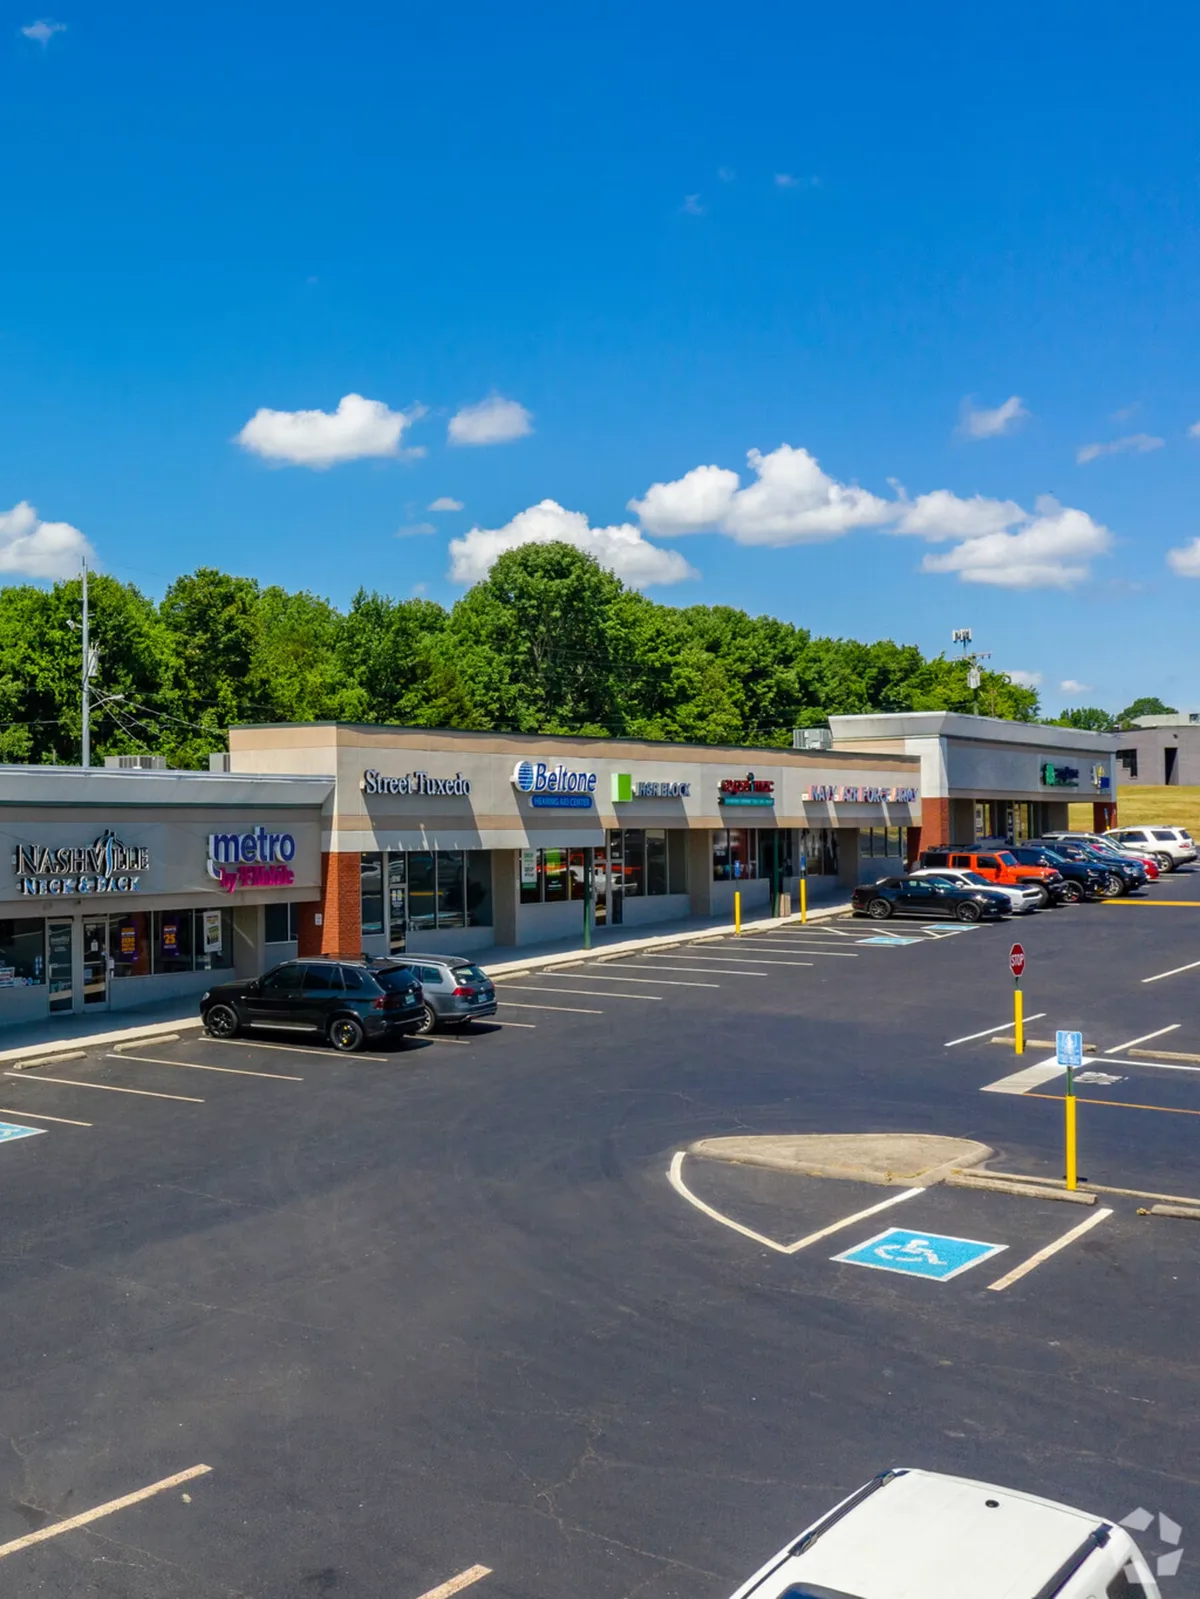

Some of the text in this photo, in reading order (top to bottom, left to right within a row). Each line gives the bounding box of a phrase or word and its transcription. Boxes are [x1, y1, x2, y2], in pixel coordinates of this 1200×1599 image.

[364, 769, 472, 796] Street Tuxedo
[534, 762, 597, 791] Beltone
[660, 782, 691, 797] BLOCK
[808, 785, 837, 802] NAVY
[860, 787, 891, 803] FORCE
[894, 787, 919, 803] ARMY
[208, 826, 295, 864] metro
[16, 839, 150, 877] NASHVILLE
[22, 874, 141, 896] NECK & BACK
[1011, 953, 1024, 966] STOP
